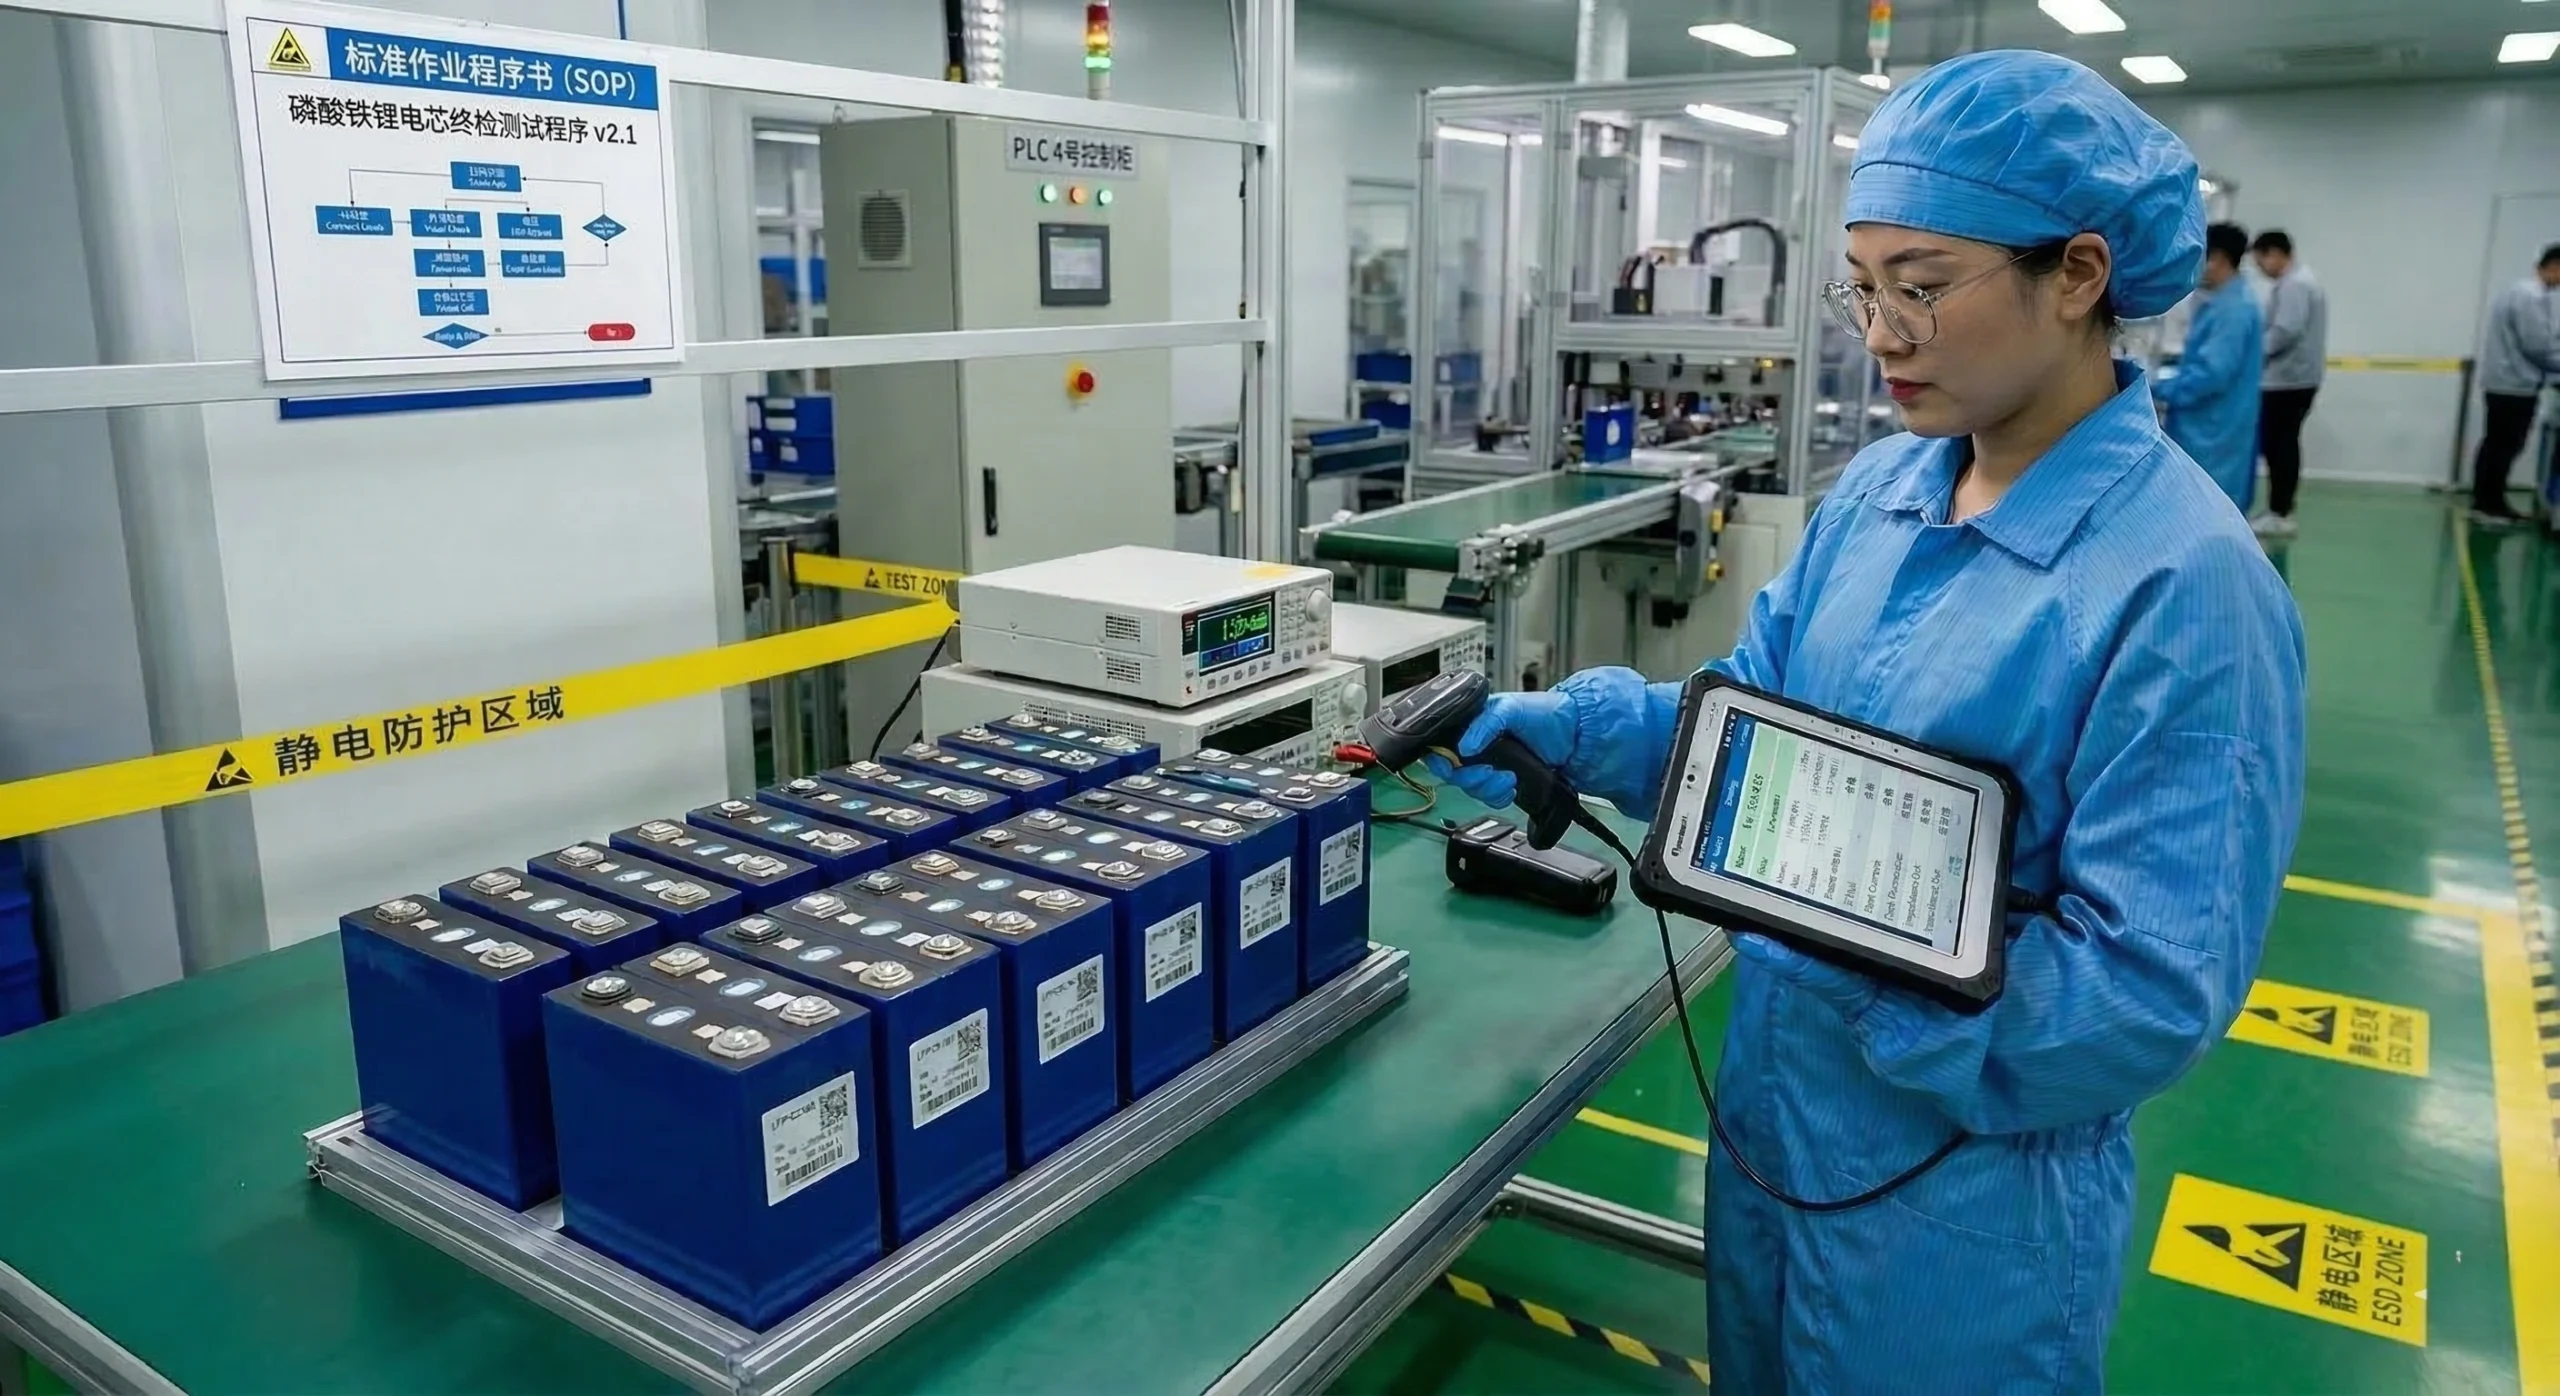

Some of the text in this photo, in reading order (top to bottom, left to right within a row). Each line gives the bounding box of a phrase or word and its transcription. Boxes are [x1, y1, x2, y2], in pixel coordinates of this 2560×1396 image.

[344, 38, 554, 92] 标准作业程序书
[287, 94, 638, 146] 磷酸铁锂电芯终检测试程序 v2.1
[1013, 136, 1049, 163] PLC
[886, 571, 918, 592] TEST
[274, 685, 565, 777] 静电防护区域
[2372, 1235, 2406, 1327] ESD ZONE
